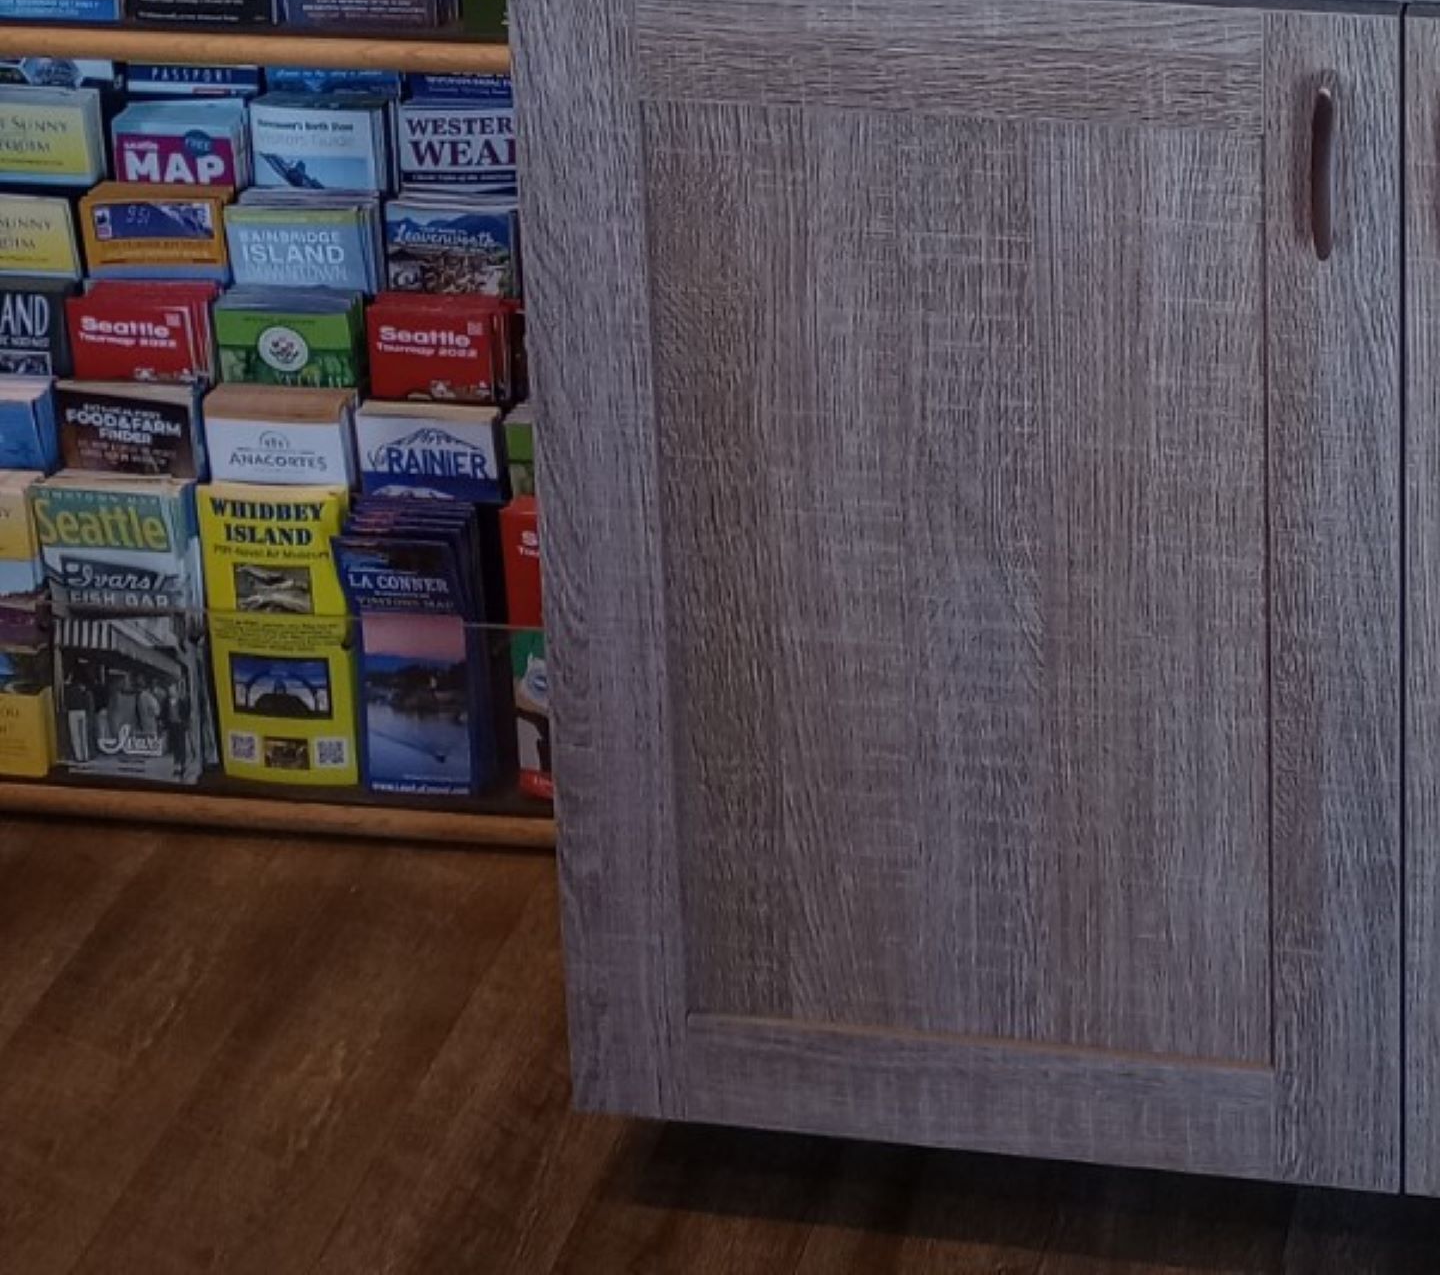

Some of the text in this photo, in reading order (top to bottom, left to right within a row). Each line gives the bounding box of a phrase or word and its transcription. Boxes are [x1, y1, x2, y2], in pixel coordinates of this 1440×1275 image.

[151, 67, 234, 82] PASSPORT
[124, 151, 226, 185] MAP
[238, 229, 341, 244] BAINBRIDGE
[394, 225, 496, 247] Leavenworth
[242, 245, 345, 264] ISLAND
[80, 315, 170, 339] Seattle
[378, 325, 471, 348] Seattle
[98, 427, 152, 445] FINDER
[228, 453, 328, 472] ANACORTES
[387, 448, 488, 480] RAINIER
[209, 497, 326, 520] WHIDBEY
[34, 496, 168, 550] Seattle
[223, 522, 312, 547] ISLAND
[347, 572, 450, 594] LA CONNER
